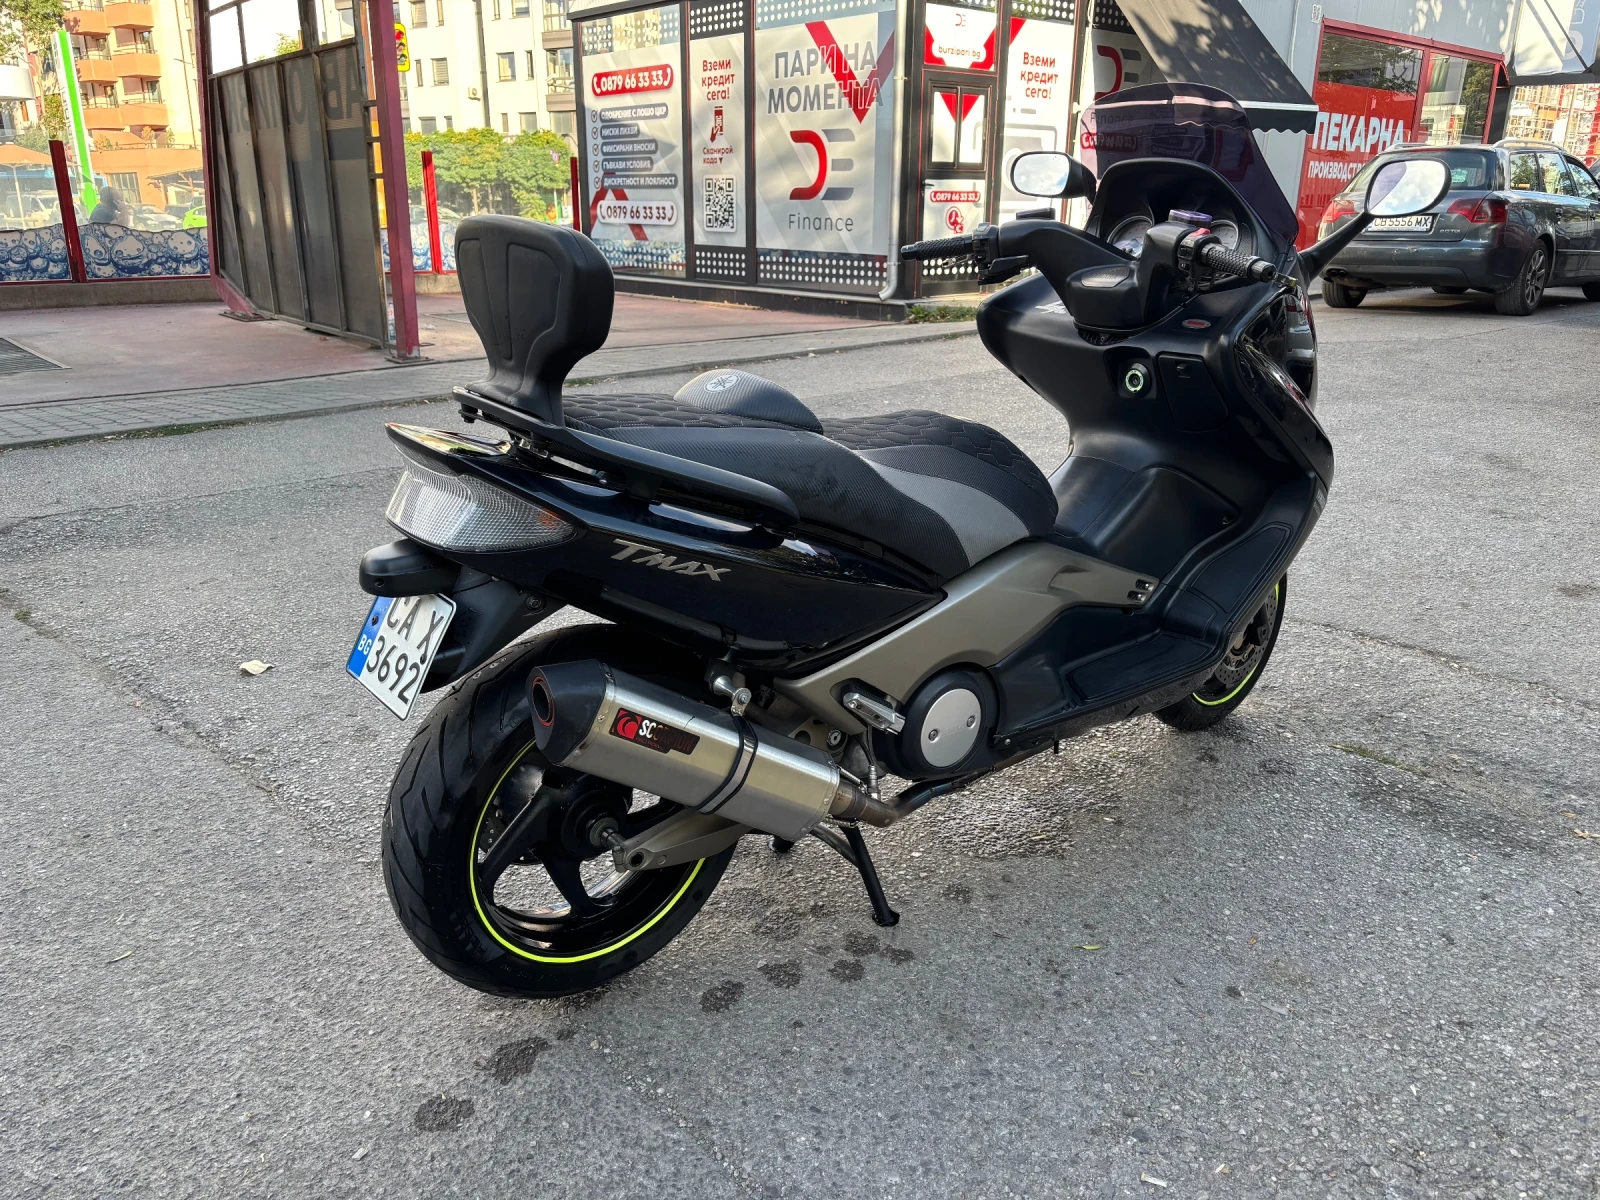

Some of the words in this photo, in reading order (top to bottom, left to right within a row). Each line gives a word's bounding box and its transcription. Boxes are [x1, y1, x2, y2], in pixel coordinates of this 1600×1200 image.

[775, 44, 837, 79] ПАРИ
[842, 40, 878, 74] НА
[938, 45, 981, 59] burzipari.bg
[1023, 52, 1056, 68] Вземи
[702, 59, 732, 72] Вземи
[600, 75, 623, 92] 0879
[625, 73, 637, 89] 66
[638, 71, 650, 87] 33
[651, 70, 663, 86] 33
[701, 73, 736, 89] кредит
[1020, 70, 1059, 84] кредит
[706, 87, 730, 101] сега!
[767, 77, 885, 114] МОМЕНТА
[1025, 87, 1052, 99] сега!
[1312, 112, 1404, 152] ПЕКАРНА
[634, 143, 656, 152] ВНОСКИ
[702, 146, 734, 155] Сканирай
[606, 205, 628, 219] 0879
[630, 205, 641, 219] 66
[642, 206, 654, 220] 33
[655, 206, 667, 220] 33
[788, 212, 855, 232] Finance
[1388, 217, 1413, 227] 5556
[1414, 216, 1431, 227] MX
[611, 538, 732, 581] TMAX
[386, 597, 421, 640] CA
[357, 634, 372, 655] BG
[366, 634, 420, 705] 3692
